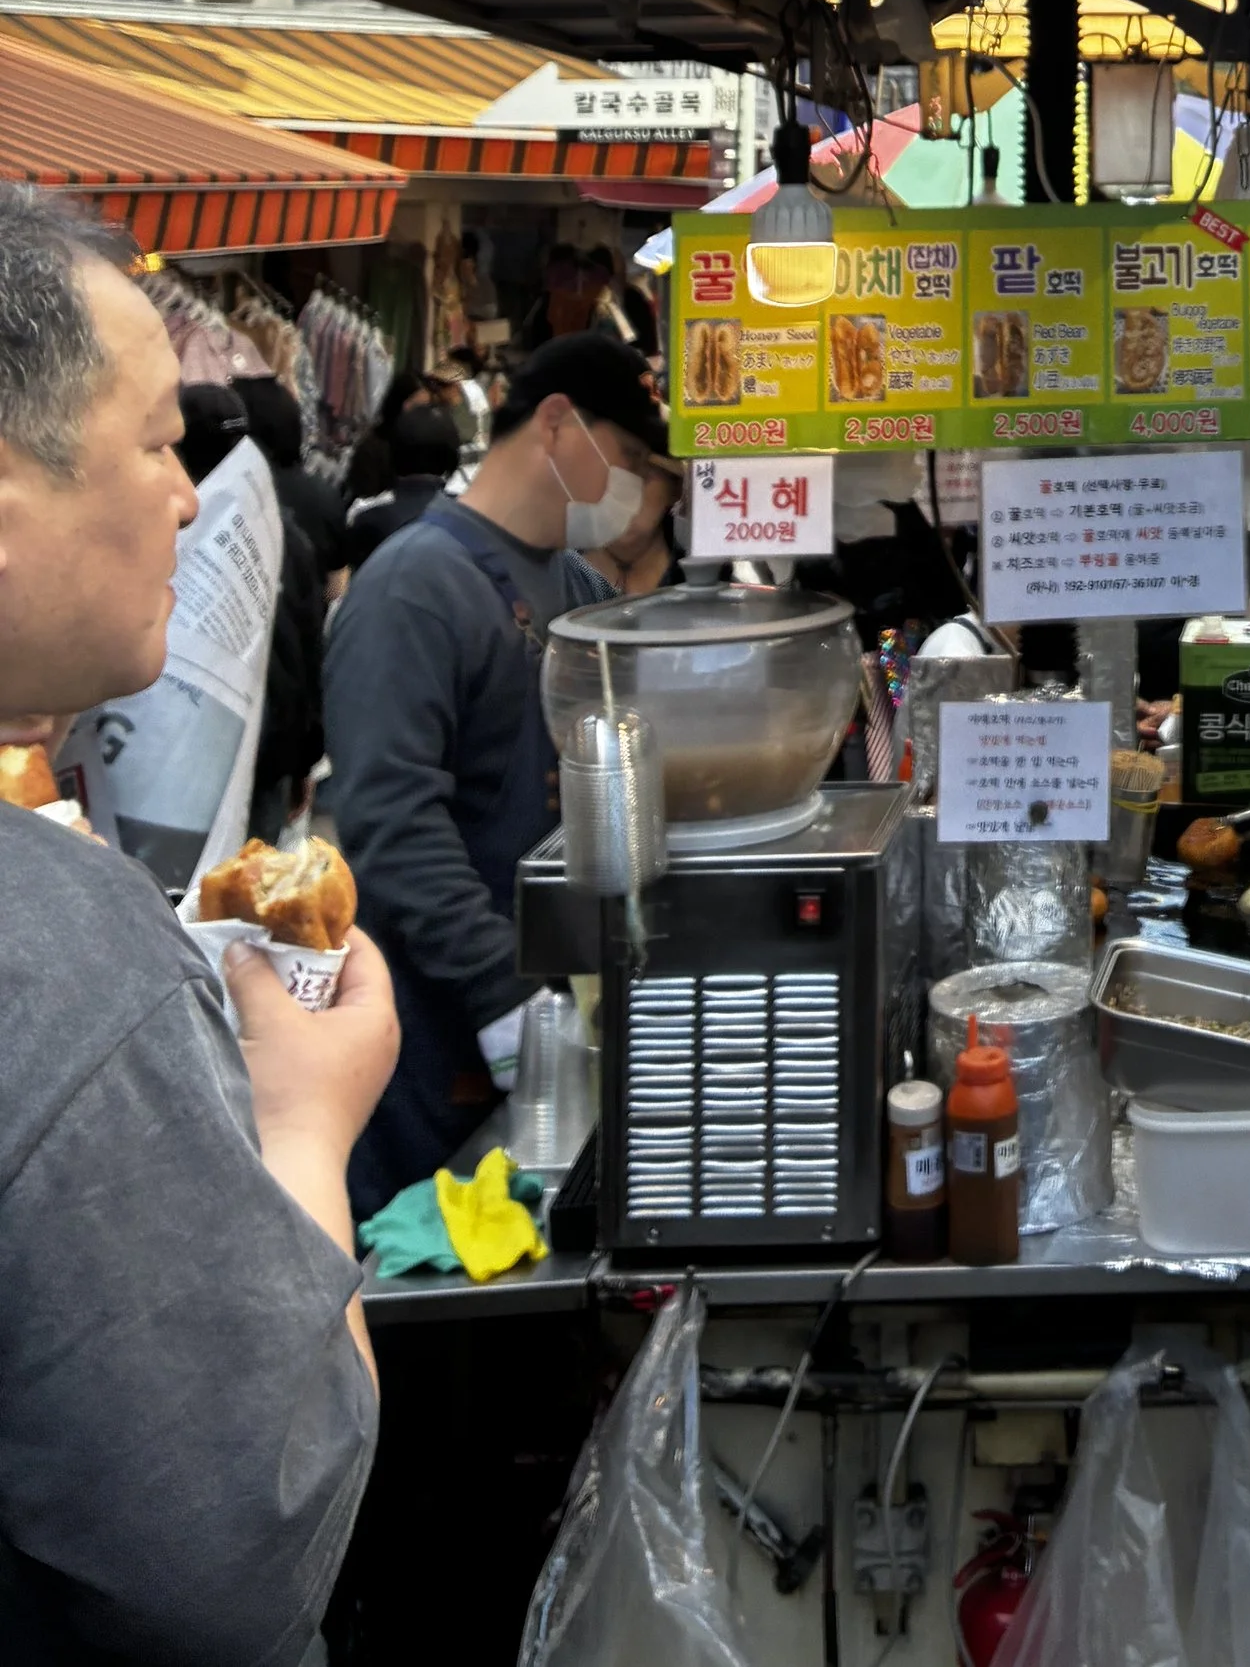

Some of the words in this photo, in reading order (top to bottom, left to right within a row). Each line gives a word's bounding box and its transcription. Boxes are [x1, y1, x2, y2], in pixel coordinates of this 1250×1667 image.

[574, 90, 700, 115] 칼국수골목
[654, 127, 696, 140] ALLEY
[1199, 206, 1239, 245] BEST
[691, 251, 736, 302] 꿀
[992, 244, 1041, 295] 팥
[1045, 269, 1083, 296] 호떡
[1113, 241, 1194, 291] 불고기
[1195, 253, 1239, 281] 호떡
[739, 327, 783, 344] Honey
[786, 325, 818, 342] Seed
[695, 419, 787, 446] 2,000원
[845, 414, 936, 445] 2,500원
[993, 409, 1083, 438] 2,500원
[1131, 408, 1221, 436] 4,000원
[724, 521, 797, 542] 2000원
